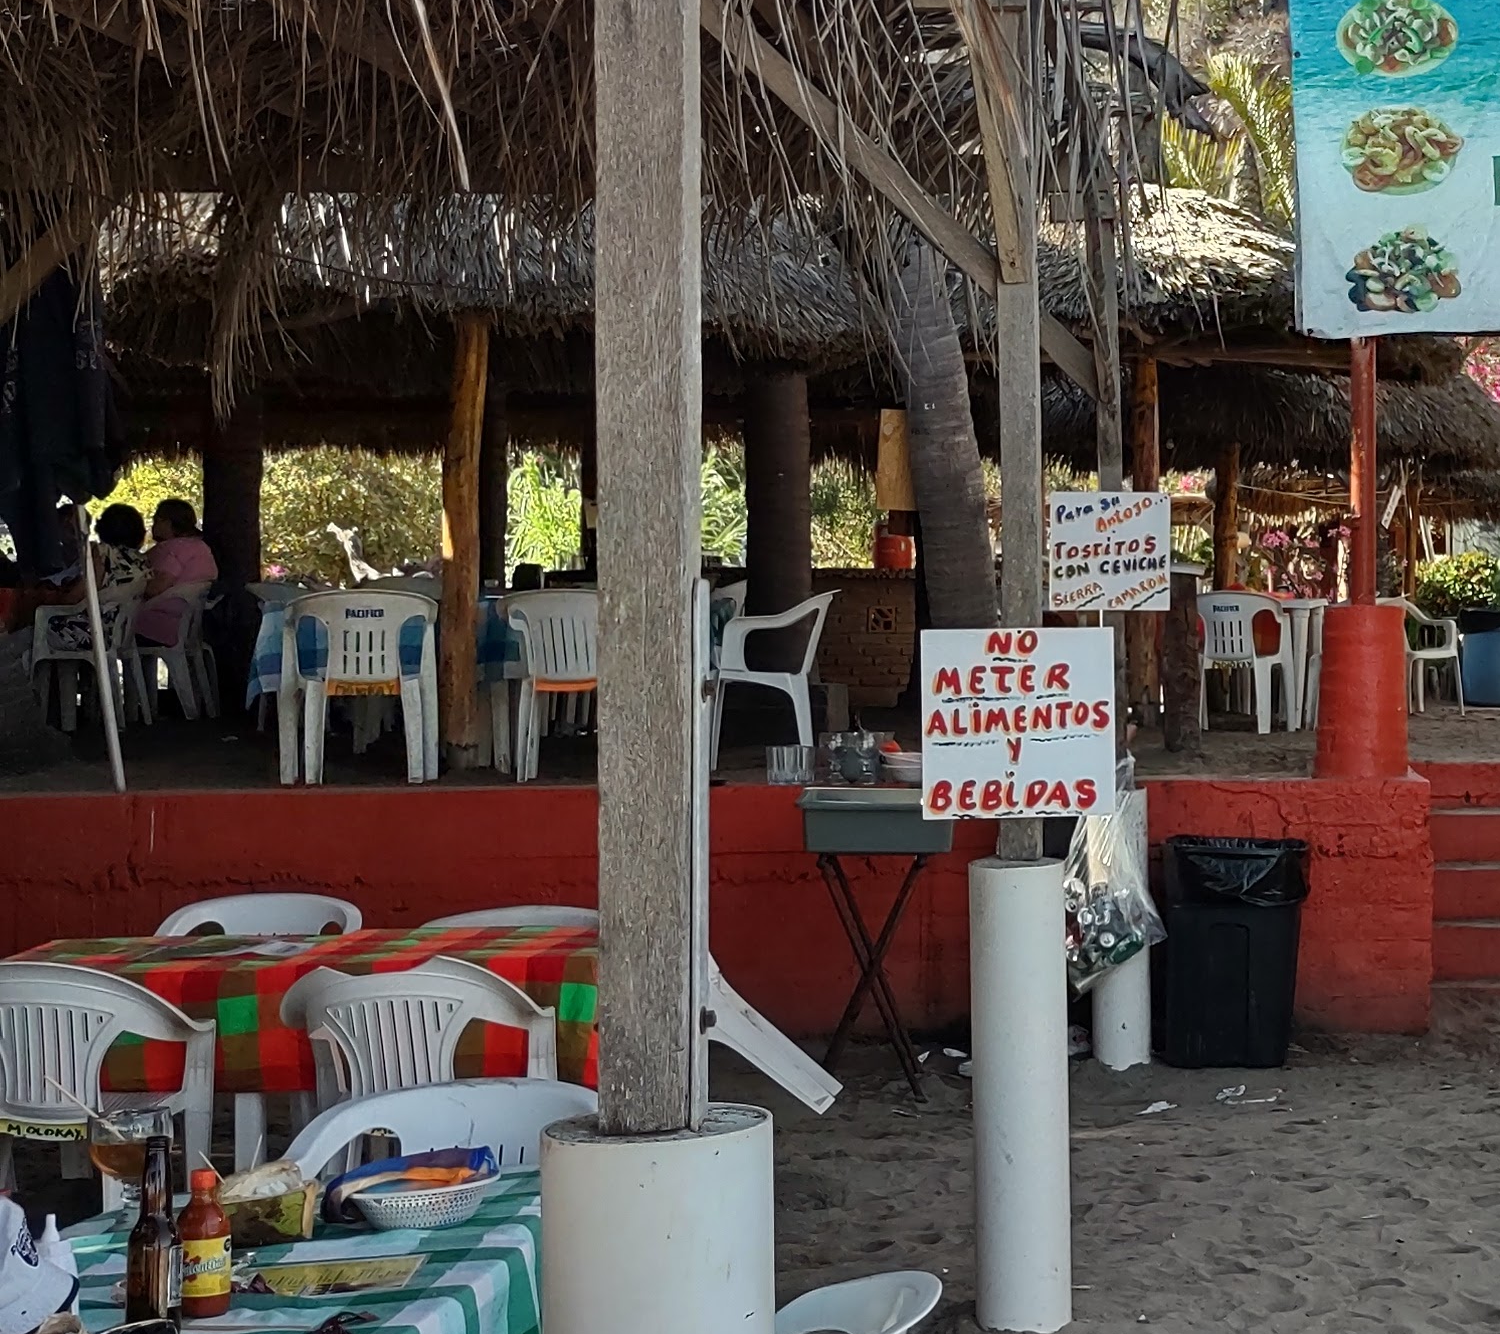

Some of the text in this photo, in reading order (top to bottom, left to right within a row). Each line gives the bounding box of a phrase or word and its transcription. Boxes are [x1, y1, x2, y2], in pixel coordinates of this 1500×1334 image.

[1054, 562, 1091, 579] CON
[986, 630, 1038, 656] NO
[933, 662, 1071, 696] METER
[1005, 737, 1022, 765] Y
